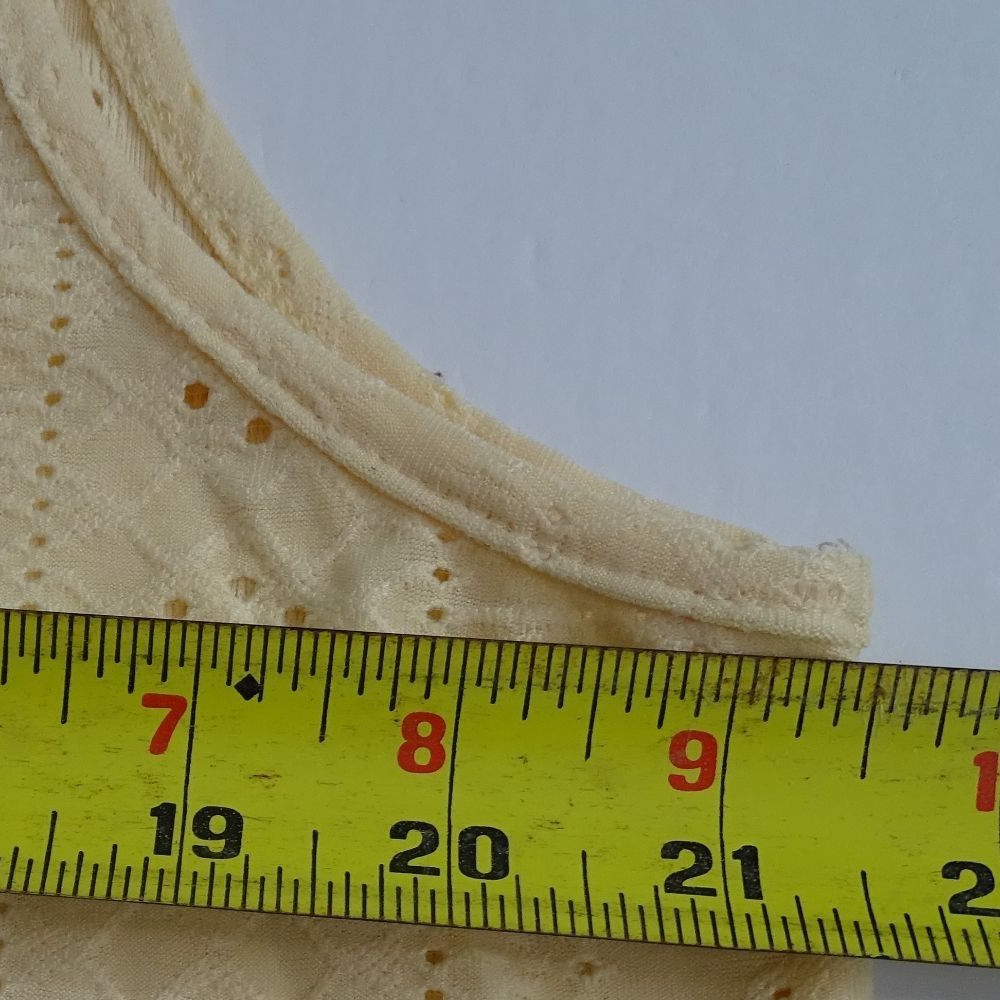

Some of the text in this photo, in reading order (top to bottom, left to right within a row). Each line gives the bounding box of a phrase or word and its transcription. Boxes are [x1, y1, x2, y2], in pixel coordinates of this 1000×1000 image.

[141, 692, 189, 755] 7
[397, 711, 448, 774] 8
[667, 730, 719, 792] 9
[149, 802, 244, 860] 19
[388, 820, 511, 881] 20
[660, 840, 765, 901] 21
